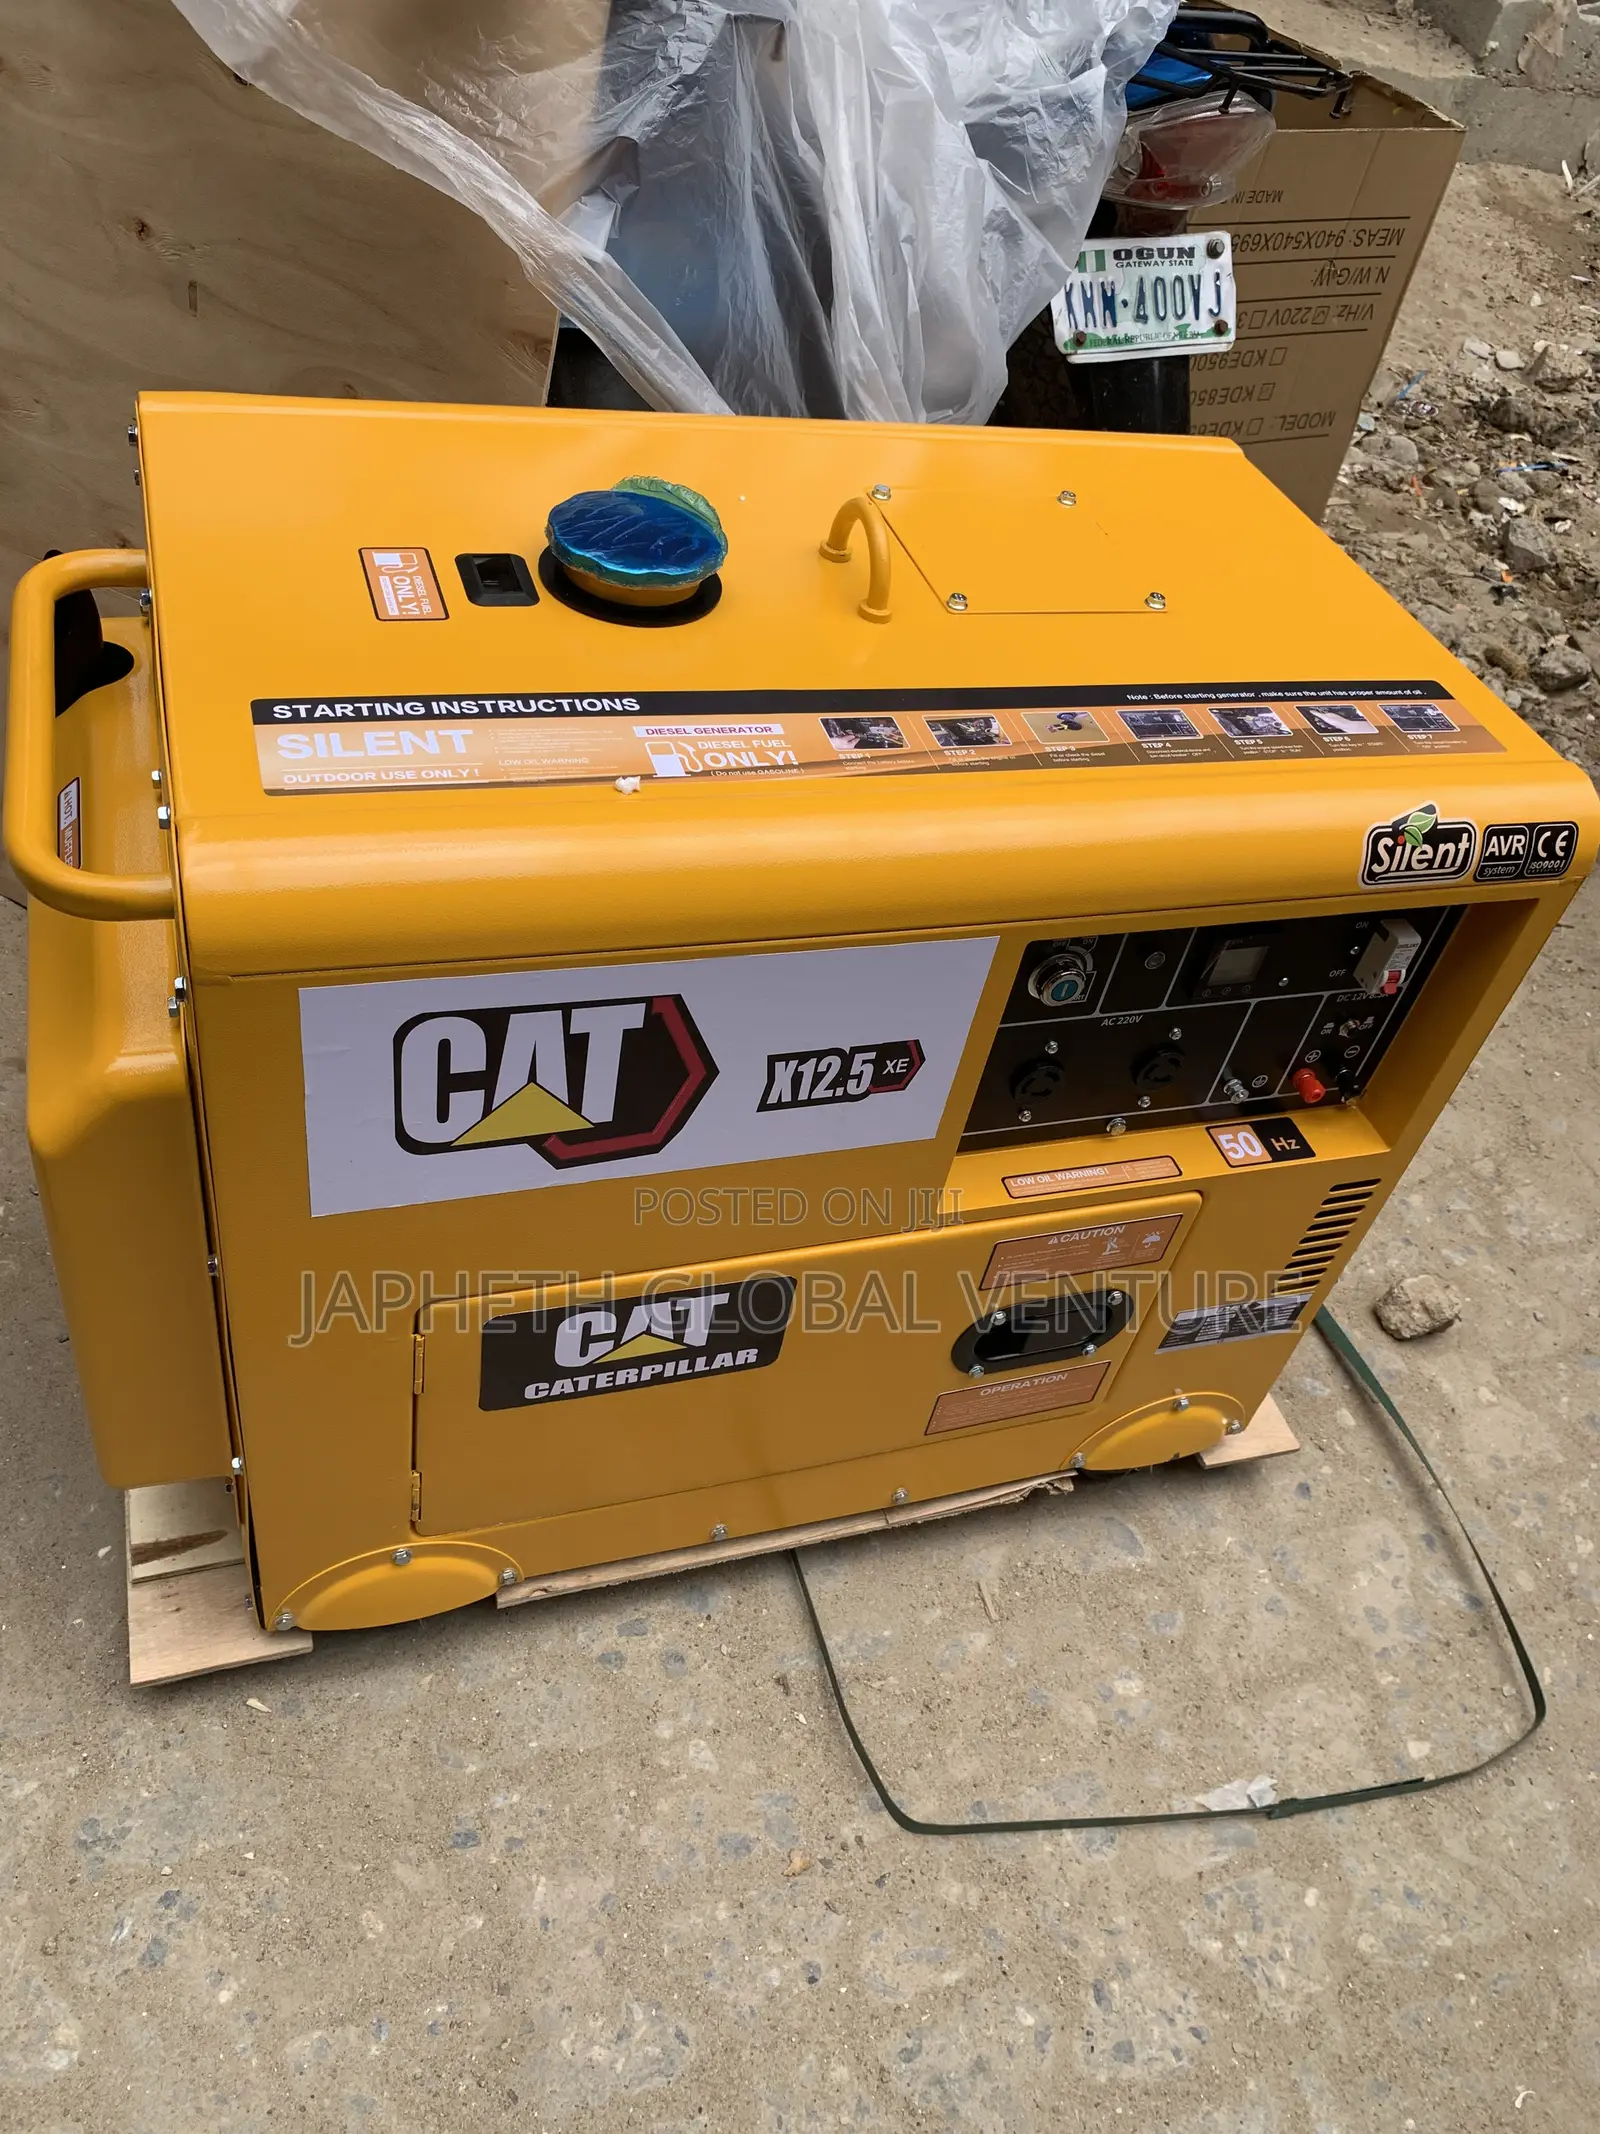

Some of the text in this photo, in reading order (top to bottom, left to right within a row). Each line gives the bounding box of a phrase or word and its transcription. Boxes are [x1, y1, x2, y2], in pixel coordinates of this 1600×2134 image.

[1245, 189, 1284, 204] MADE
[1348, 227, 1406, 247] MEAS:
[1113, 246, 1196, 261] OGUN
[1115, 259, 1194, 269] GATEWAY STATE
[392, 575, 421, 616] ONLY!
[412, 575, 433, 616] DIESEL FUEL
[1183, 691, 1216, 700] starting
[1216, 691, 1256, 699] generator
[272, 697, 641, 719] STARTING INSTRUCTIONS
[645, 726, 773, 736] DIESEL GENERATOR
[277, 729, 474, 760] SILENT
[697, 739, 792, 750] DIESEL FUEL
[542, 757, 590, 765] WARNING
[703, 750, 799, 768] ONLY!
[283, 772, 377, 785] OUTDOOR
[380, 770, 418, 781] USE
[421, 768, 471, 780] ONLY
[1371, 832, 1470, 874] Silent
[1485, 834, 1526, 857] AVR
[1537, 830, 1569, 858] CE
[1483, 865, 1515, 877] system
[1530, 860, 1566, 870] ISO9001
[1356, 921, 1370, 929] ON
[1329, 968, 1347, 977] OFF
[1101, 1014, 1144, 1027] AC 220V
[401, 1002, 647, 1144] CAT
[766, 1051, 910, 1105] X12.5 XE
[1218, 1131, 1301, 1159] 50 Hz
[1010, 1176, 1036, 1188] LOW
[1036, 1174, 1054, 1184] OIL
[1055, 1167, 1110, 1182] WARNING!
[1060, 1225, 1126, 1244] CAUTION
[554, 1292, 730, 1368] CAT
[524, 1347, 759, 1400] CATERPILLAR
[979, 1372, 1069, 1397] OPERATION
